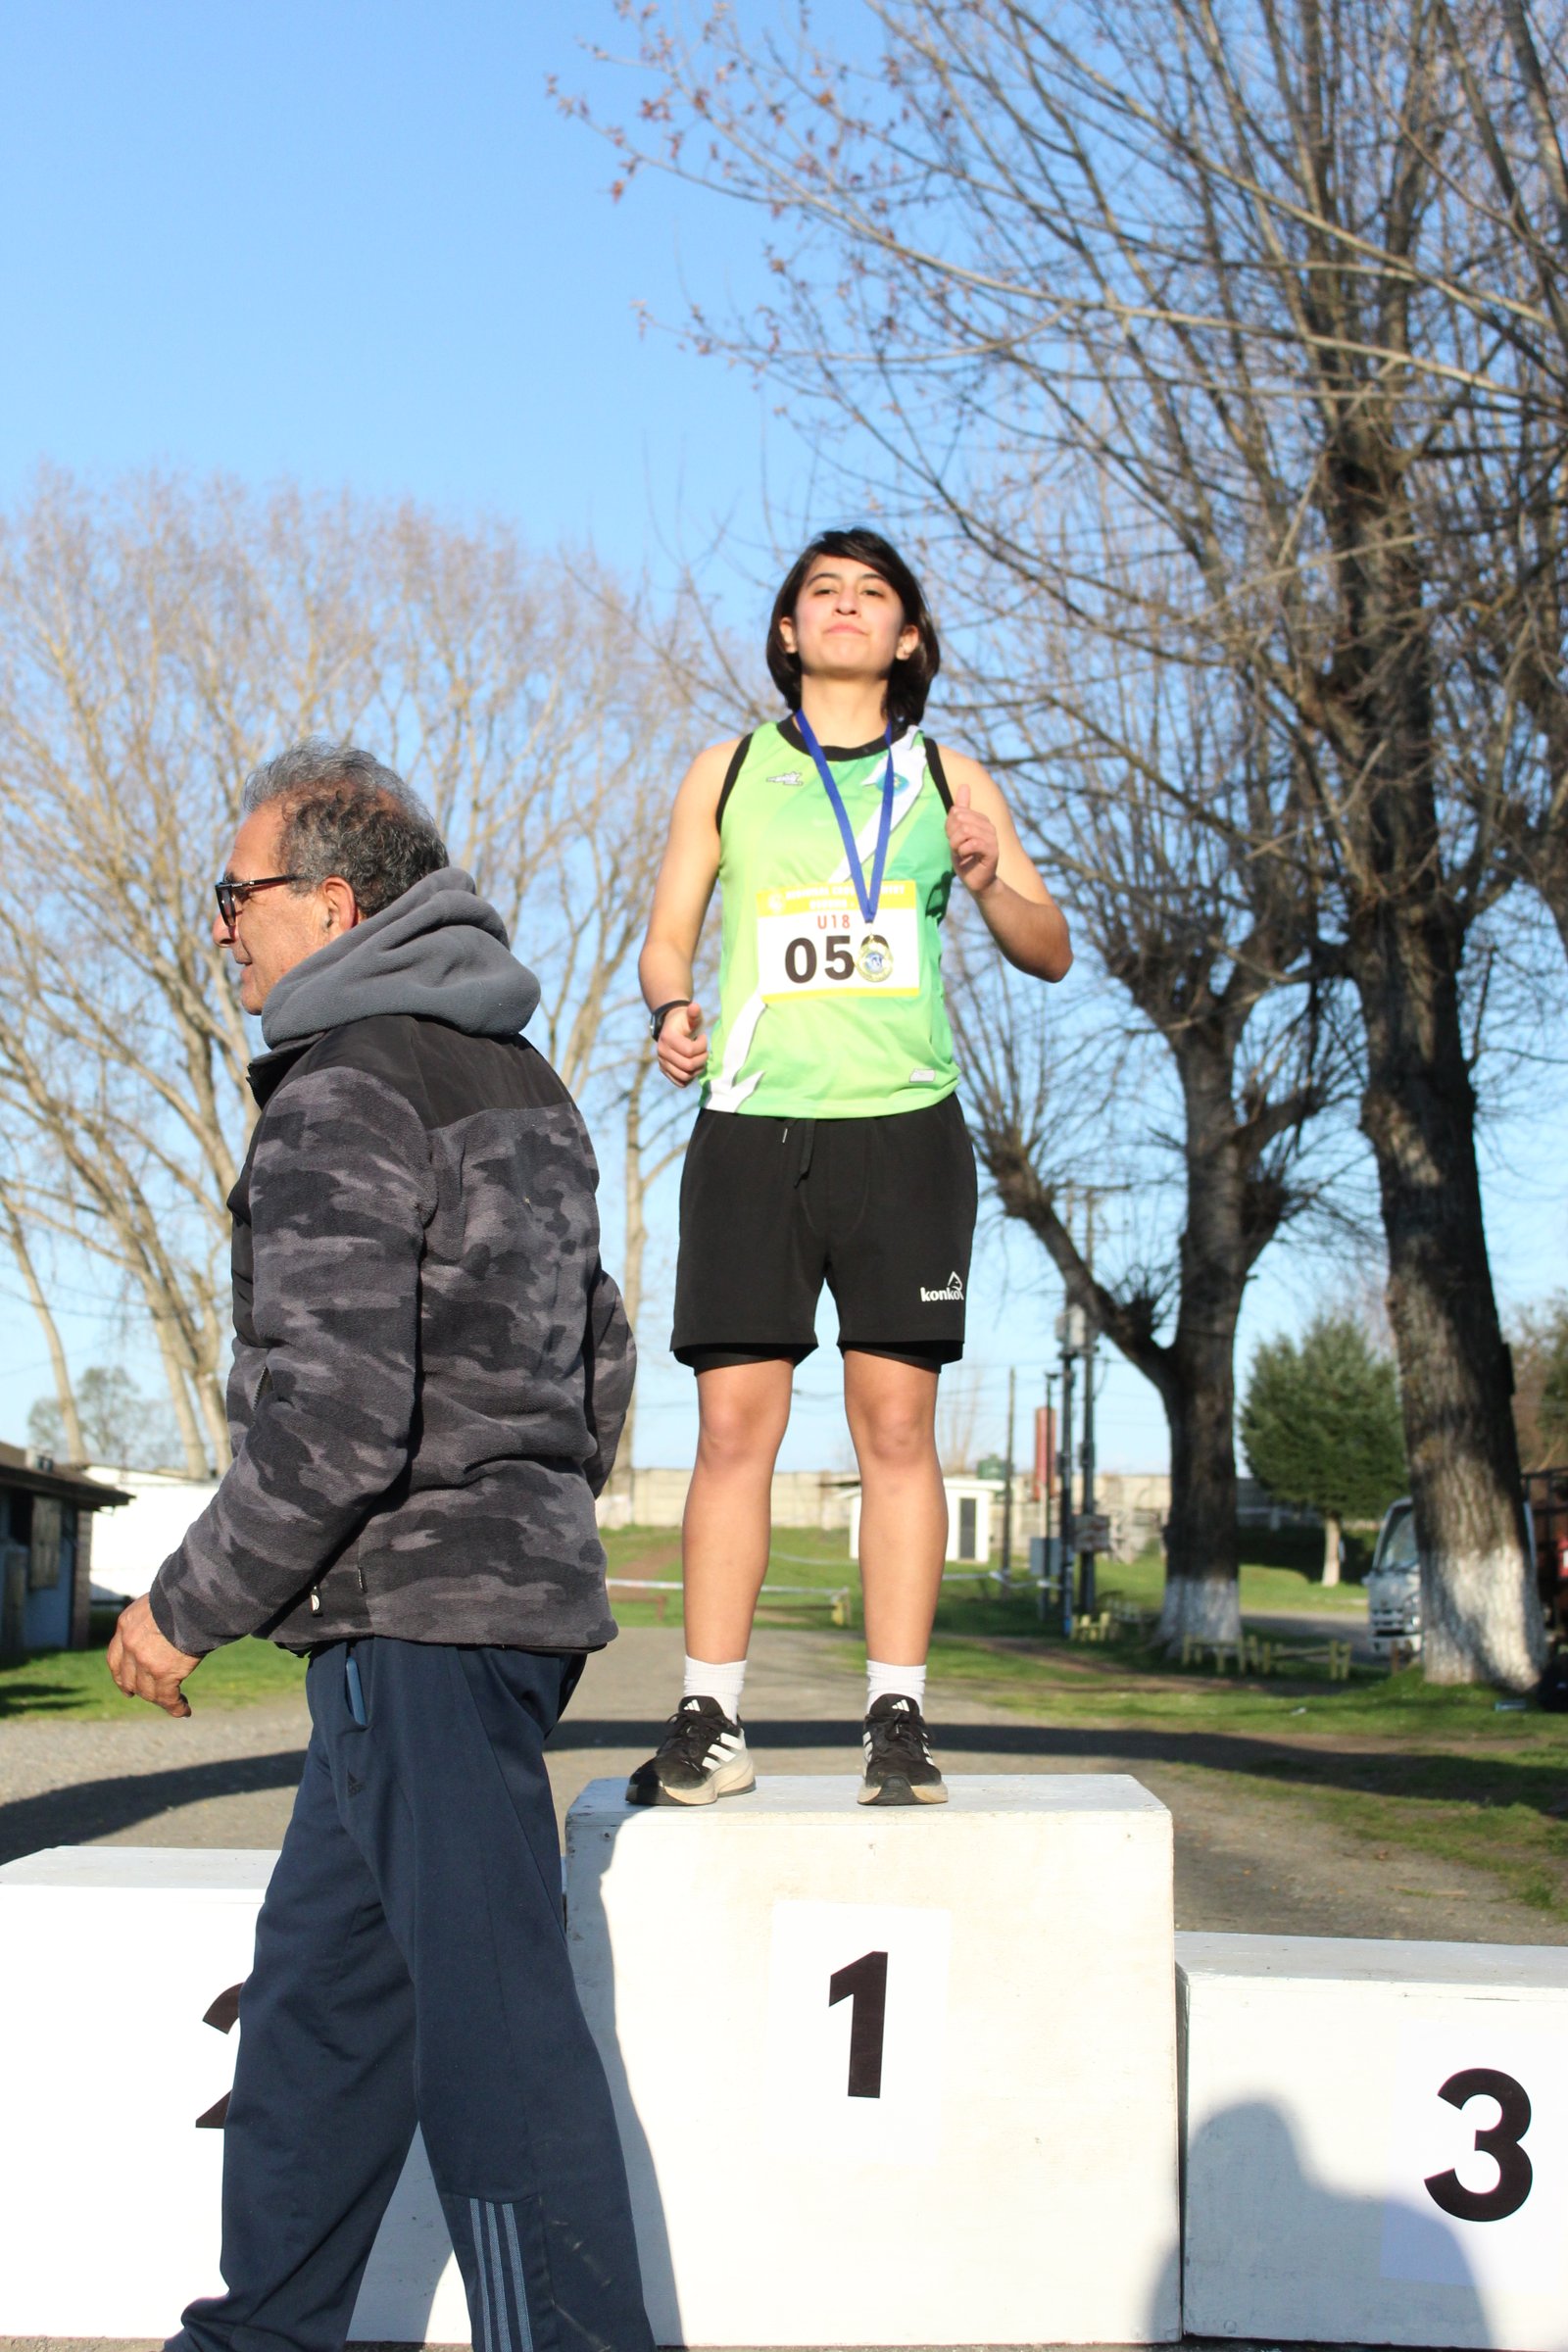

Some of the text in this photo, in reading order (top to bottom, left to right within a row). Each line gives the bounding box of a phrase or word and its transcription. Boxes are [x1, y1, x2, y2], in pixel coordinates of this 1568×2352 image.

[784, 934, 890, 984] 05
[817, 913, 851, 930] U18
[828, 1951, 889, 2099] 1
[1424, 2068, 1533, 2223] 3
